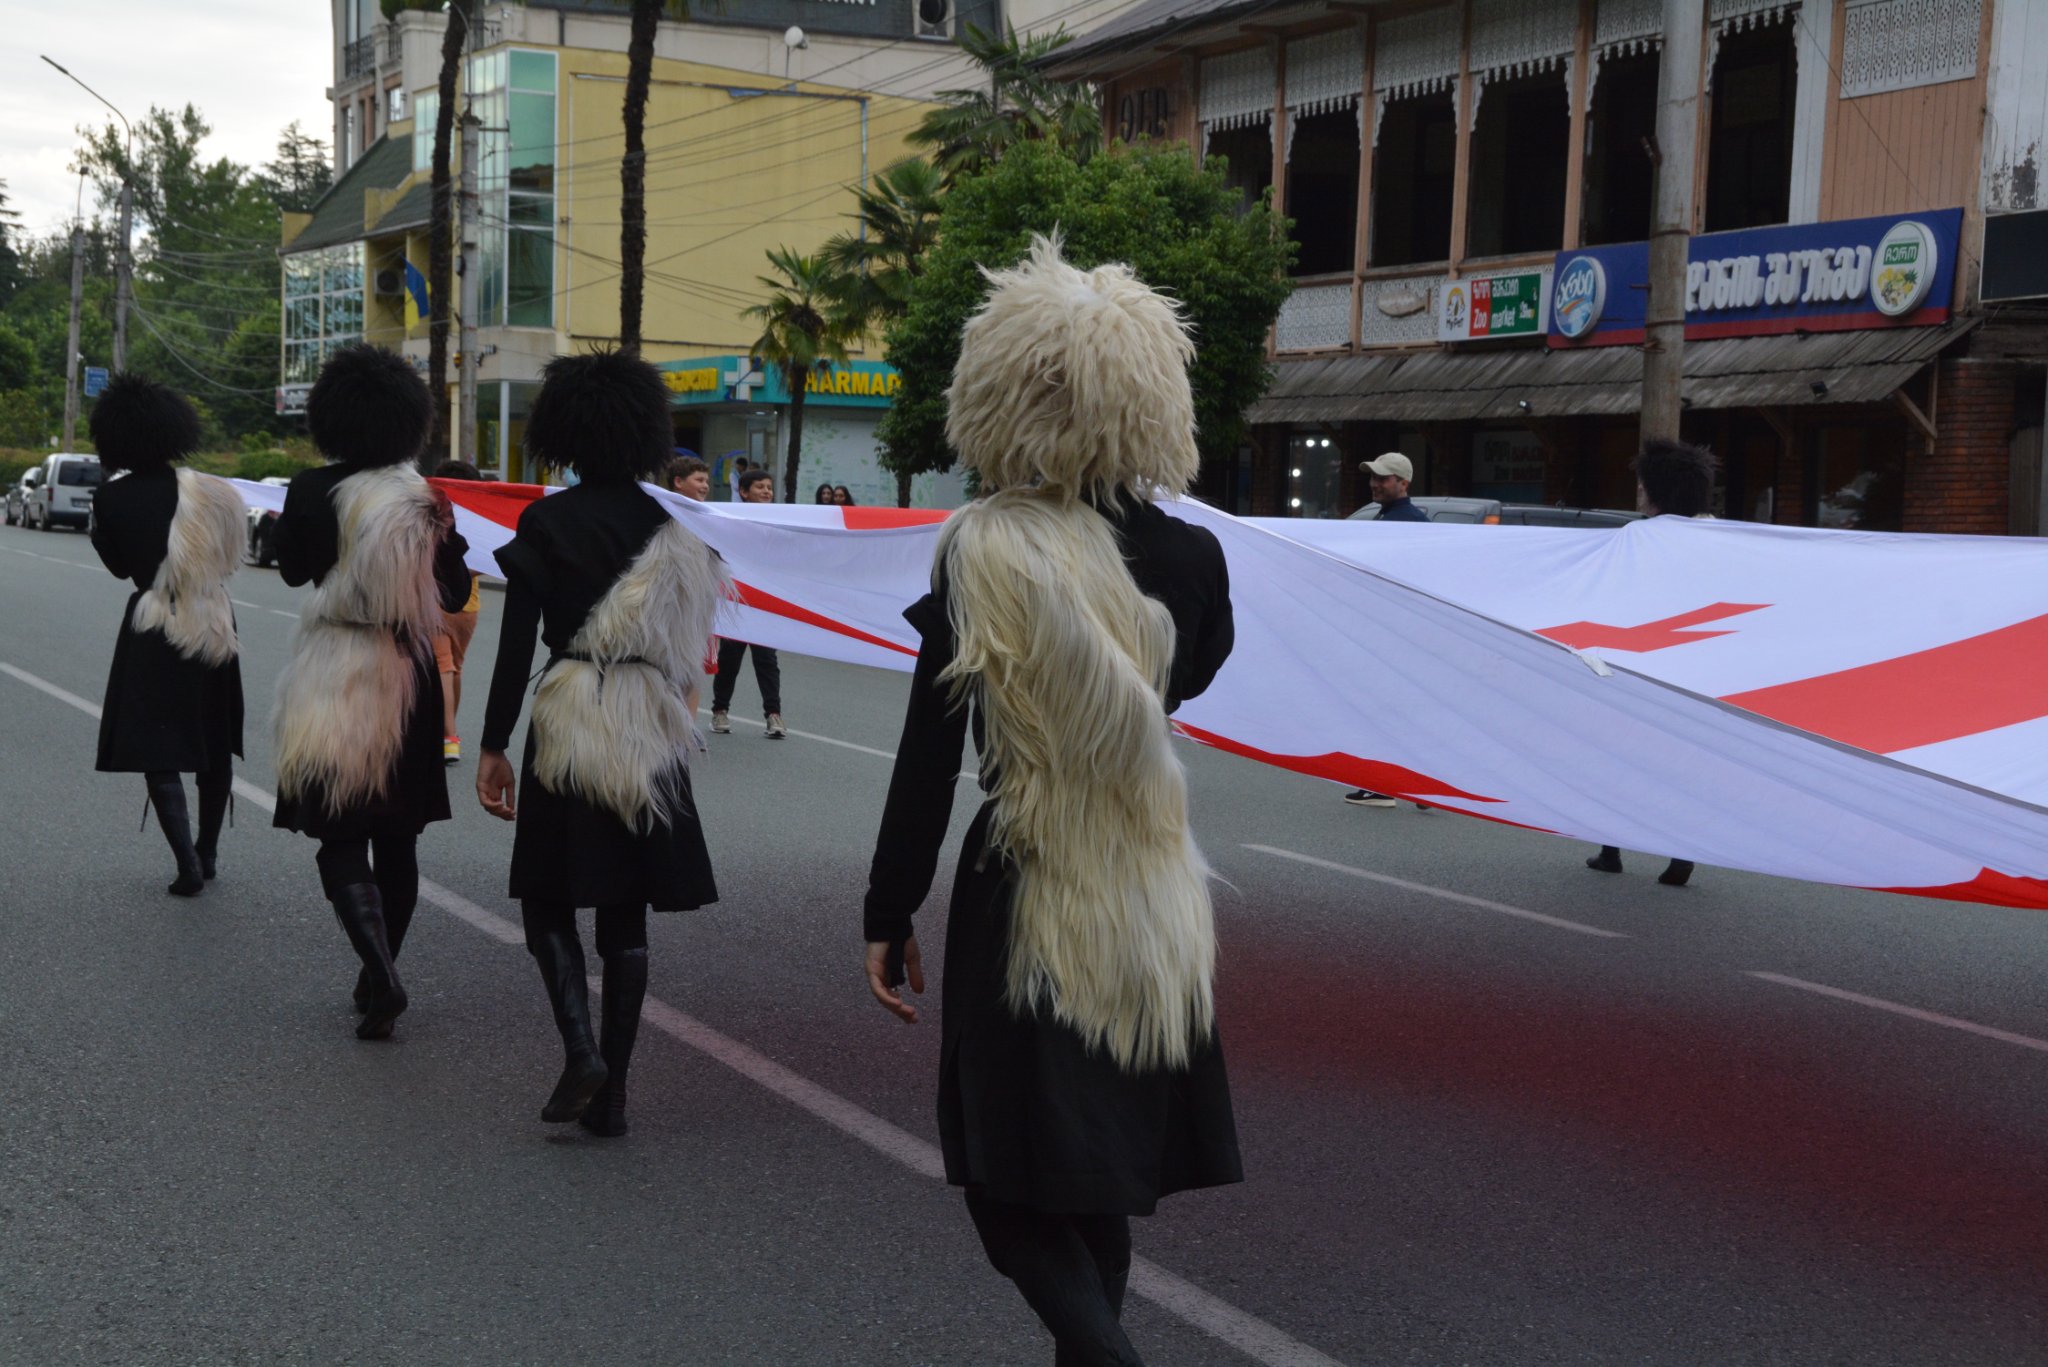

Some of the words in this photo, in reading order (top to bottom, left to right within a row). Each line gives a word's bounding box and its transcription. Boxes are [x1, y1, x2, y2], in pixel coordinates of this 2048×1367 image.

[1685, 255, 1765, 312] დანის
[1473, 308, 1487, 329] Zoo
[1490, 305, 1516, 329] market
